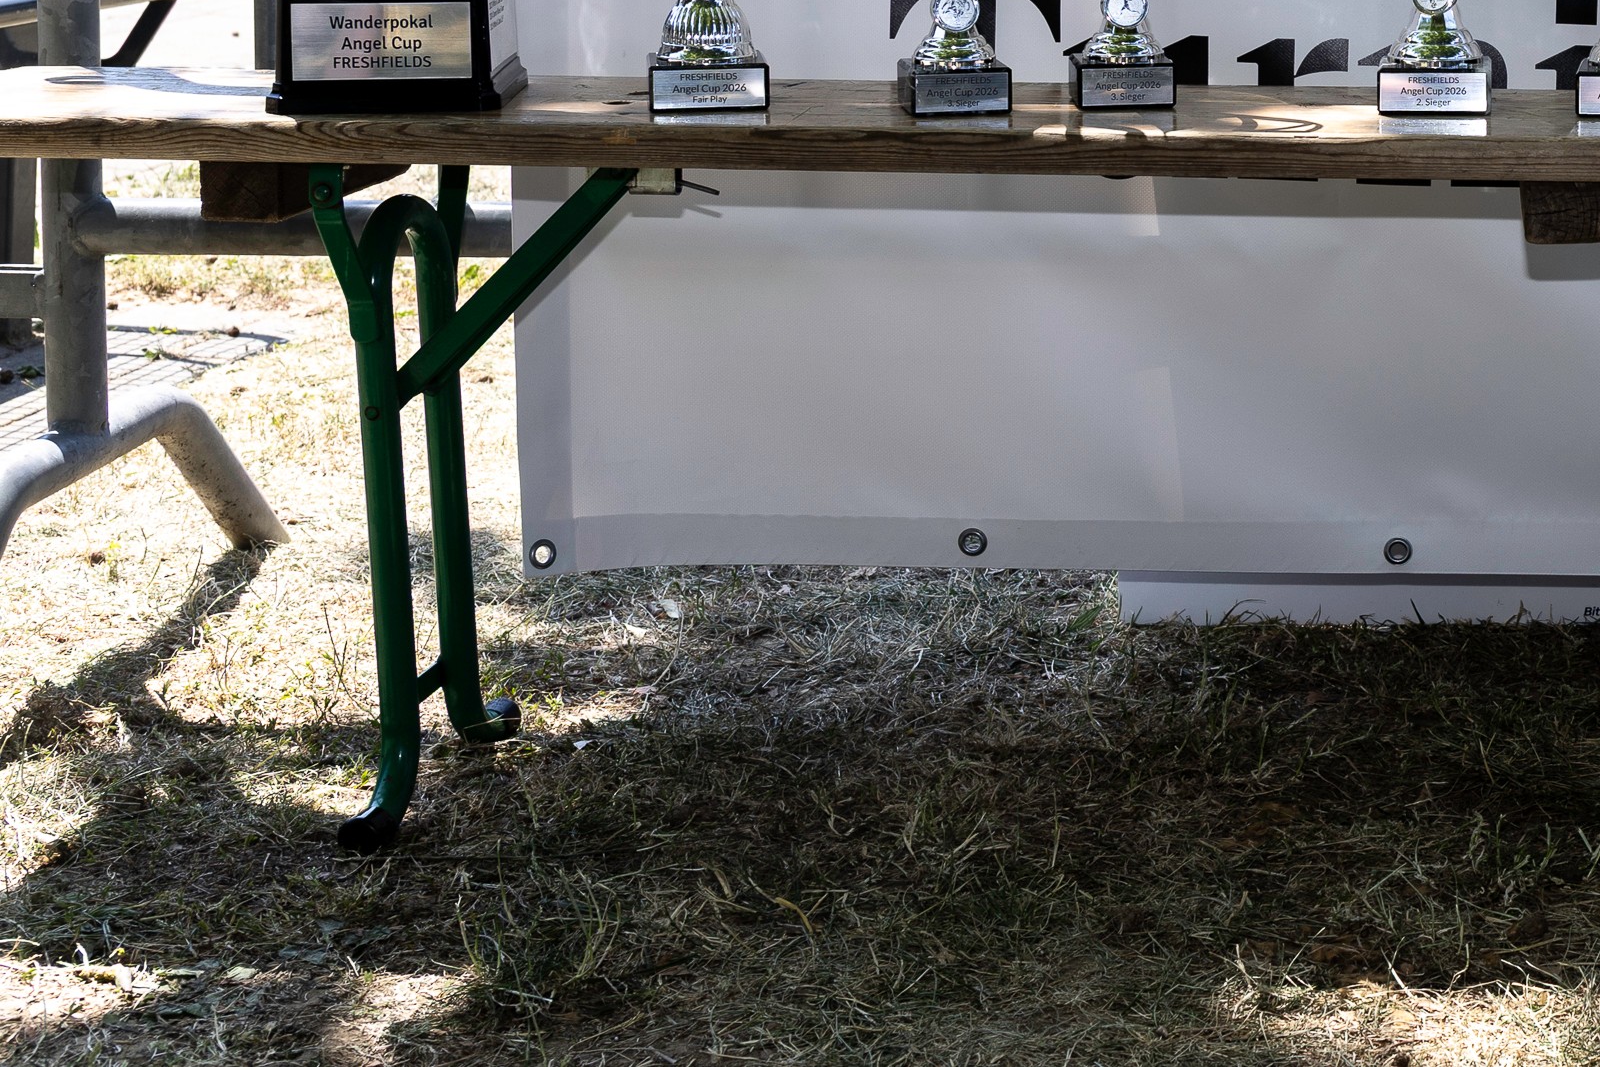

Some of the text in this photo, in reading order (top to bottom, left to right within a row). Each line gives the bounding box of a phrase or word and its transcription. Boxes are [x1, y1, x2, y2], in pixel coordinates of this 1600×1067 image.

[329, 14, 433, 31] Wanderpokal
[341, 36, 422, 53] Angel Cup
[333, 56, 432, 69] FRESHFIELDS
[680, 73, 737, 81] FRESHFIELDS
[936, 76, 991, 85] FRESHFIELDS
[672, 83, 746, 94] Angel Cup 2026
[1095, 81, 1160, 91] Angel Cup 2026
[927, 87, 998, 98] Angel Cup 2026
[1401, 87, 1467, 96] Angel Cup 2026
[710, 96, 727, 104] Play
[1120, 93, 1145, 101] Sieger
[956, 100, 979, 108] Sieger
[1416, 98, 1451, 107] 2. Sieger
